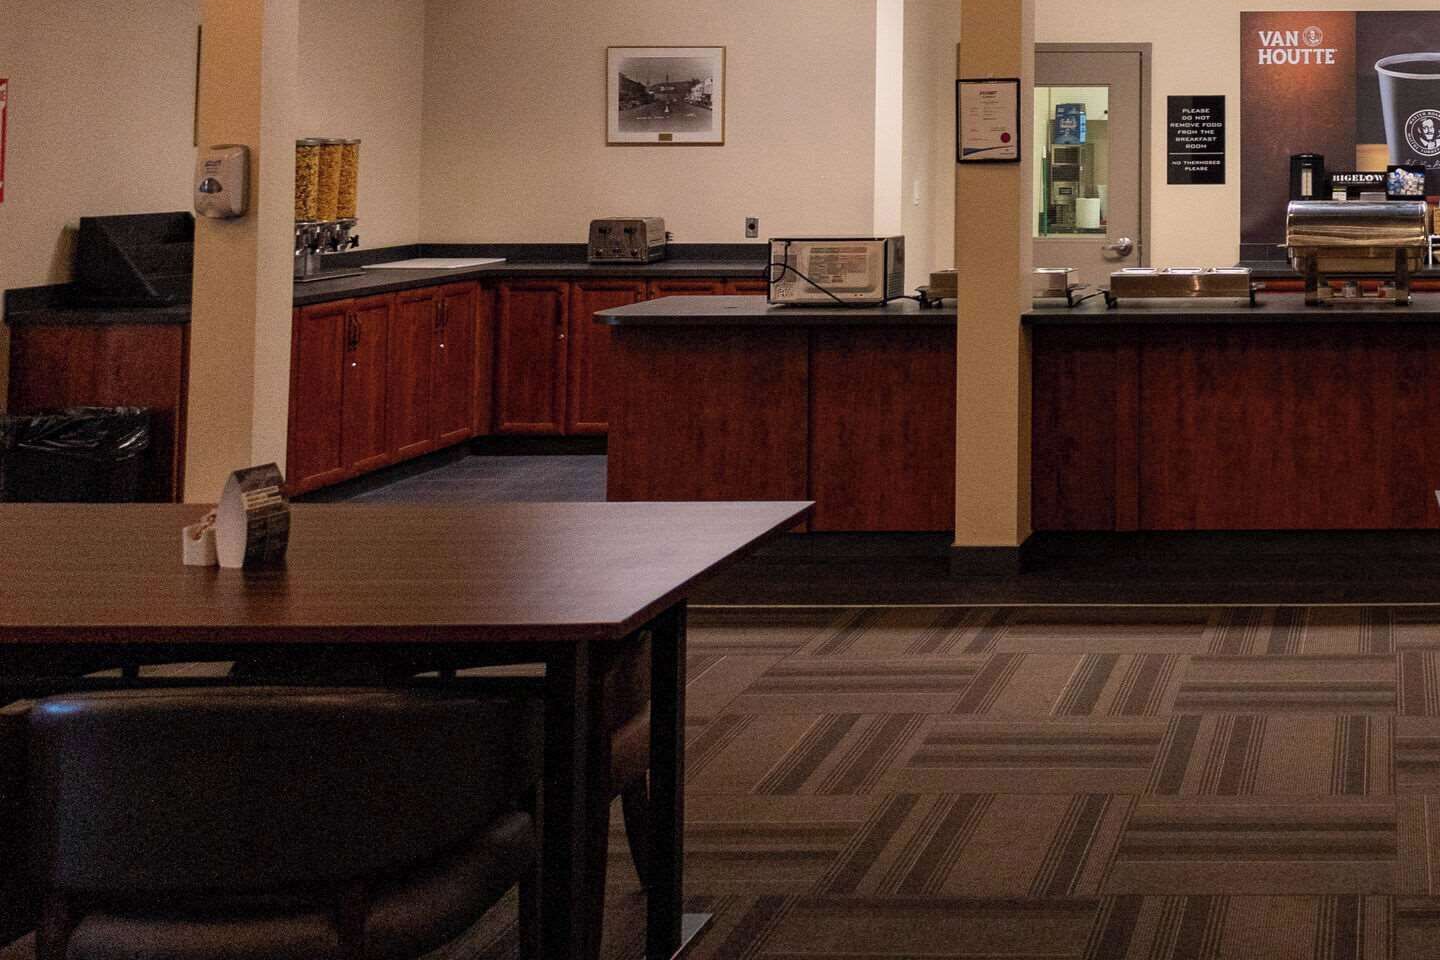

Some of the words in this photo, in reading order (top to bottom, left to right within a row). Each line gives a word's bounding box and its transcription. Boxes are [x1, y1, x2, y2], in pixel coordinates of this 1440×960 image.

[1258, 30, 1299, 46] VAN
[1258, 48, 1335, 65] HOUTTE
[1332, 174, 1385, 182] BIGELOW
